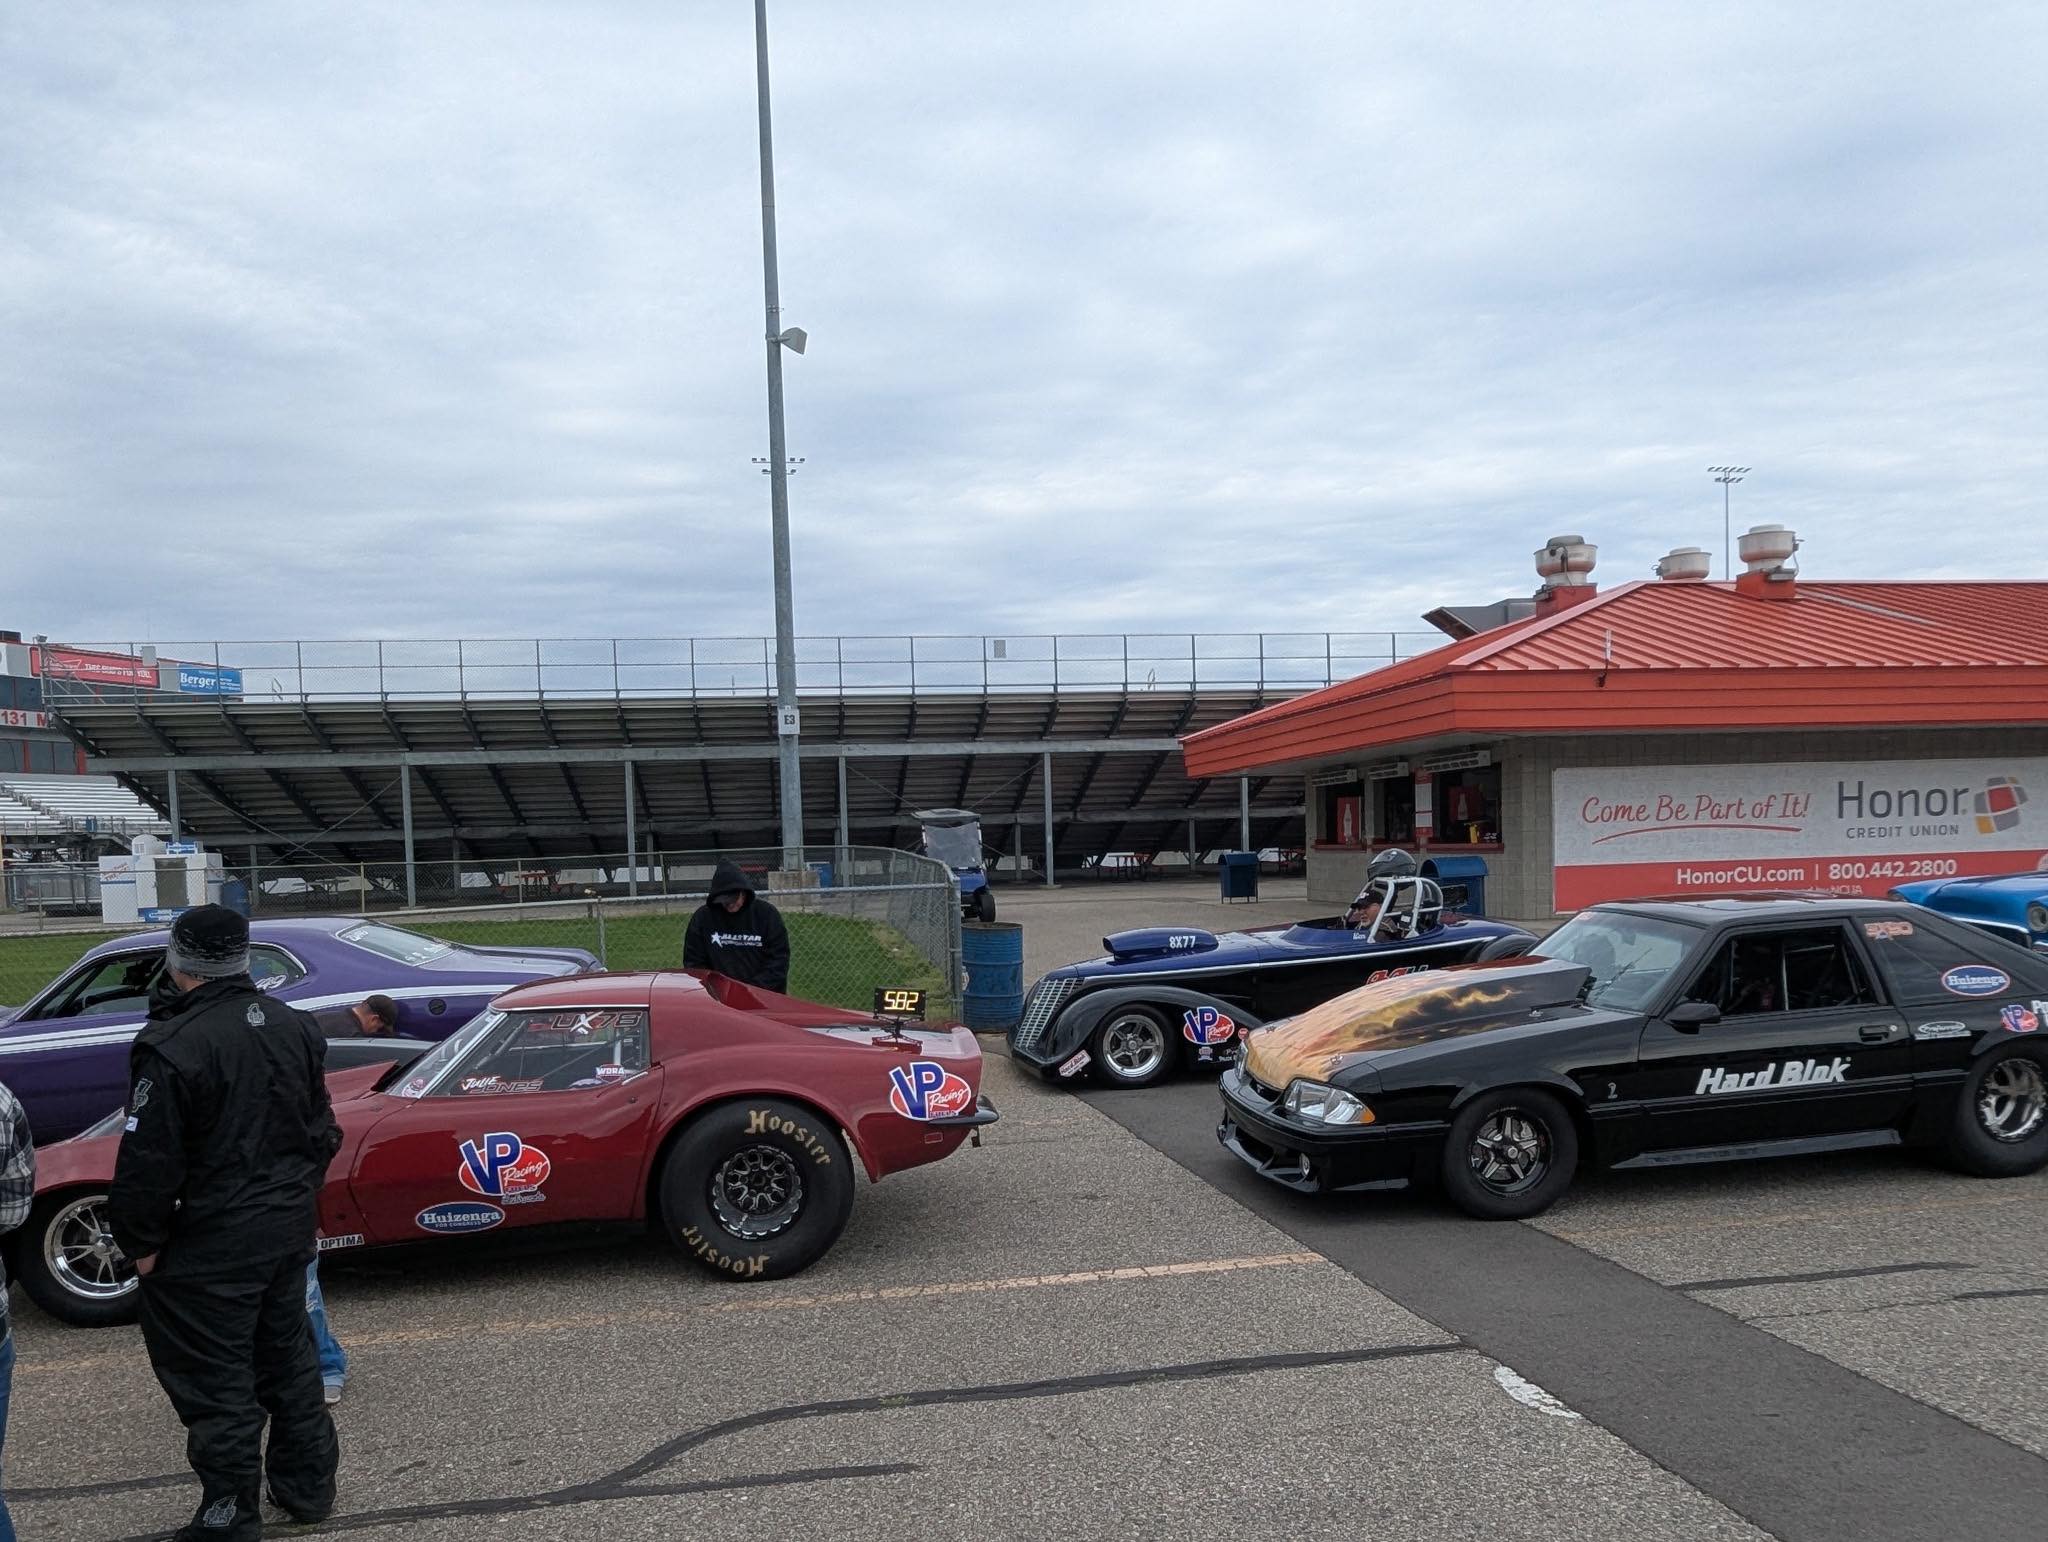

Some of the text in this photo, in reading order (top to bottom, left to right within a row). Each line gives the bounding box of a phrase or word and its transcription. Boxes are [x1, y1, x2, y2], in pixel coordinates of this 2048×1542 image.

[180, 672, 217, 688] Berger
[784, 714, 796, 725] E3
[1582, 792, 1811, 823] Come Be Part of It!
[1838, 780, 1969, 819] Honor
[1846, 824, 1960, 839] CREDIT UNION
[1676, 860, 1957, 885] HonorCU.com 800.442.2800
[1169, 935, 1196, 949] 8X77
[1947, 975, 2006, 987] Huizenga
[884, 991, 919, 1010] 582
[1183, 1007, 1219, 1044] VP
[1208, 1022, 1231, 1037] Racing
[597, 1066, 625, 1076] WDRA
[1695, 1056, 1851, 1095] Hard Blok
[461, 1076, 501, 1091] JULIE
[469, 1080, 544, 1093] JONES
[889, 1061, 945, 1120] VP
[929, 1088, 967, 1111] Racing
[744, 1110, 832, 1164] Hoosier
[460, 1132, 521, 1195] VP
[503, 1160, 545, 1186] Racing
[423, 1211, 501, 1224] Huizenga
[321, 1235, 363, 1249] OPTIMA
[681, 1225, 770, 1276] Hoosier
